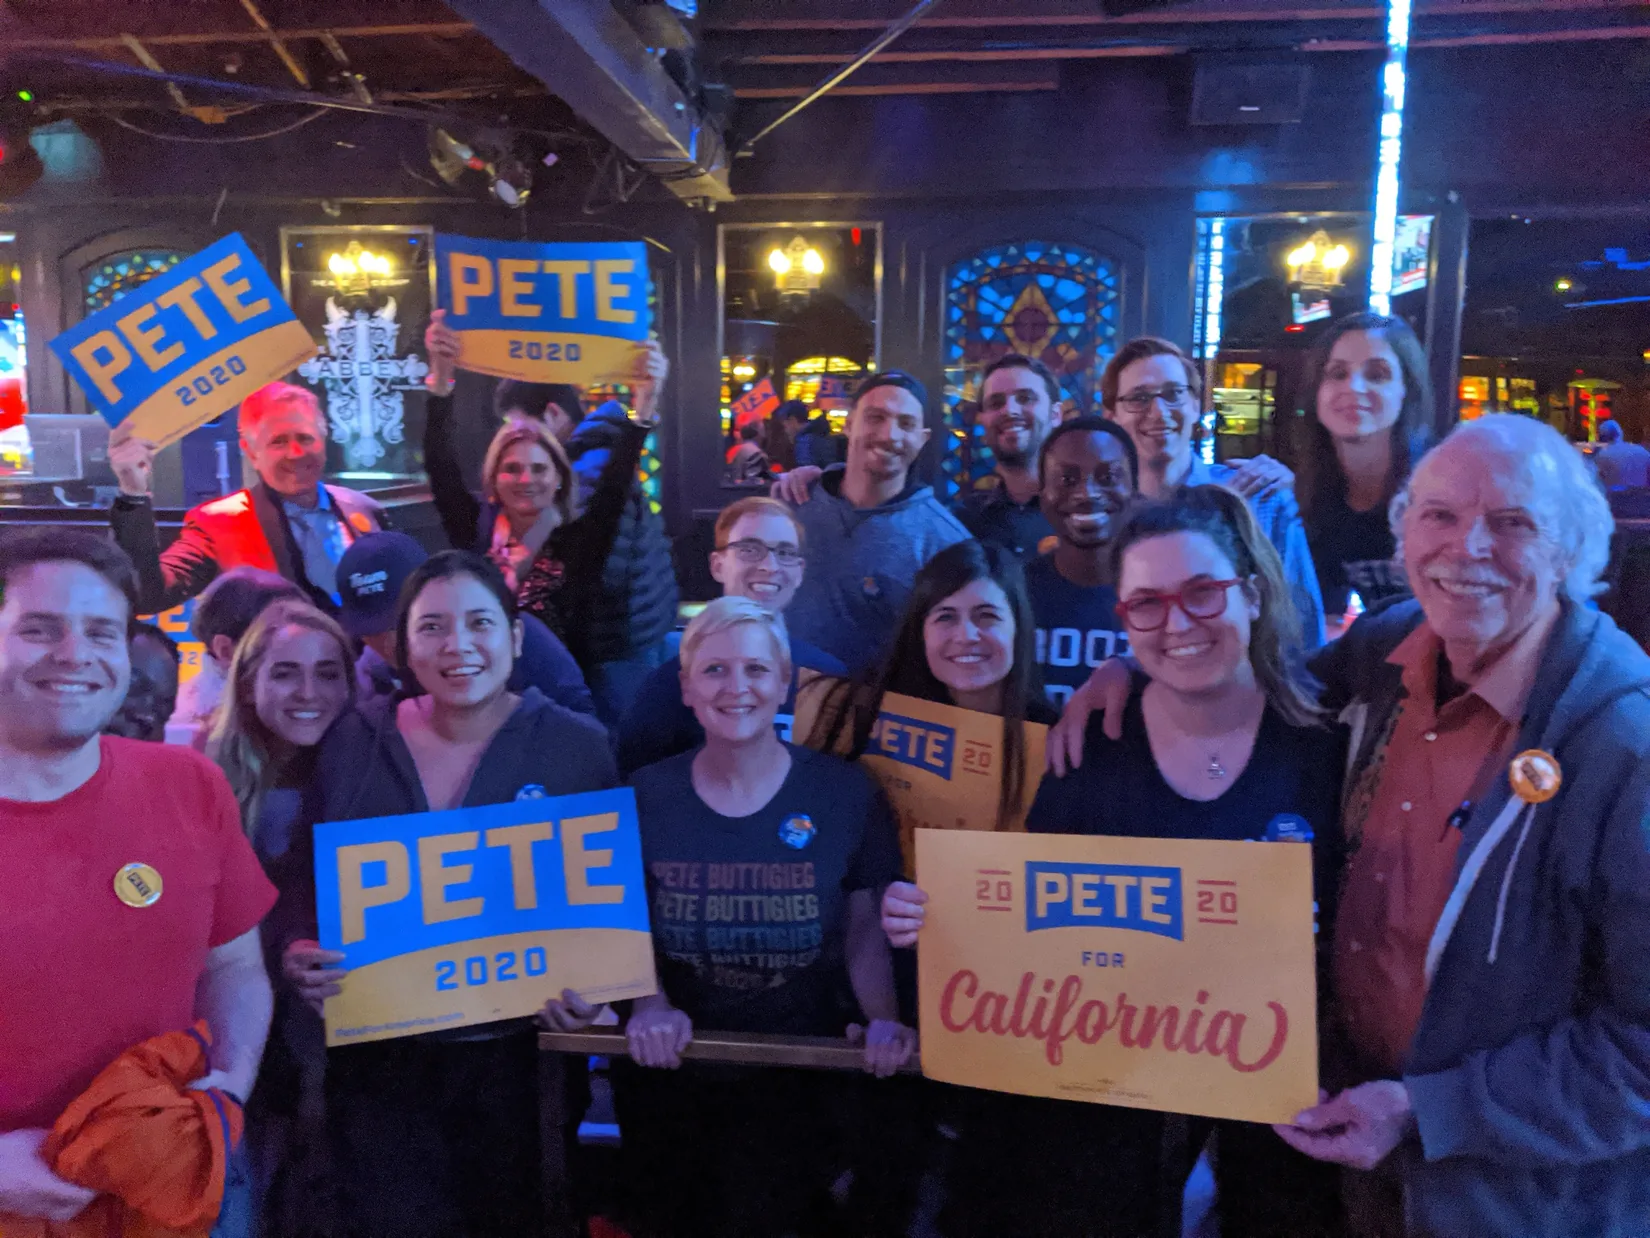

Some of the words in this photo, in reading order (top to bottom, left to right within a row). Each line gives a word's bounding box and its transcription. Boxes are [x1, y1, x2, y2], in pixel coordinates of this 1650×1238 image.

[449, 252, 637, 324] PETE
[71, 253, 271, 405] PETE
[509, 340, 582, 361] 2020
[175, 355, 248, 406] 2020
[319, 361, 408, 377] ABBEY
[962, 747, 992, 768] 20
[336, 811, 625, 946] PETE
[707, 861, 816, 890] BUTTIGIEG
[705, 893, 820, 922] BUTTIGIEG
[976, 879, 1013, 902] 20
[1034, 871, 1173, 926] PETE
[1196, 890, 1238, 914] 20
[435, 946, 547, 991] 2020
[1081, 951, 1125, 968] FOR
[939, 968, 1289, 1073] California
